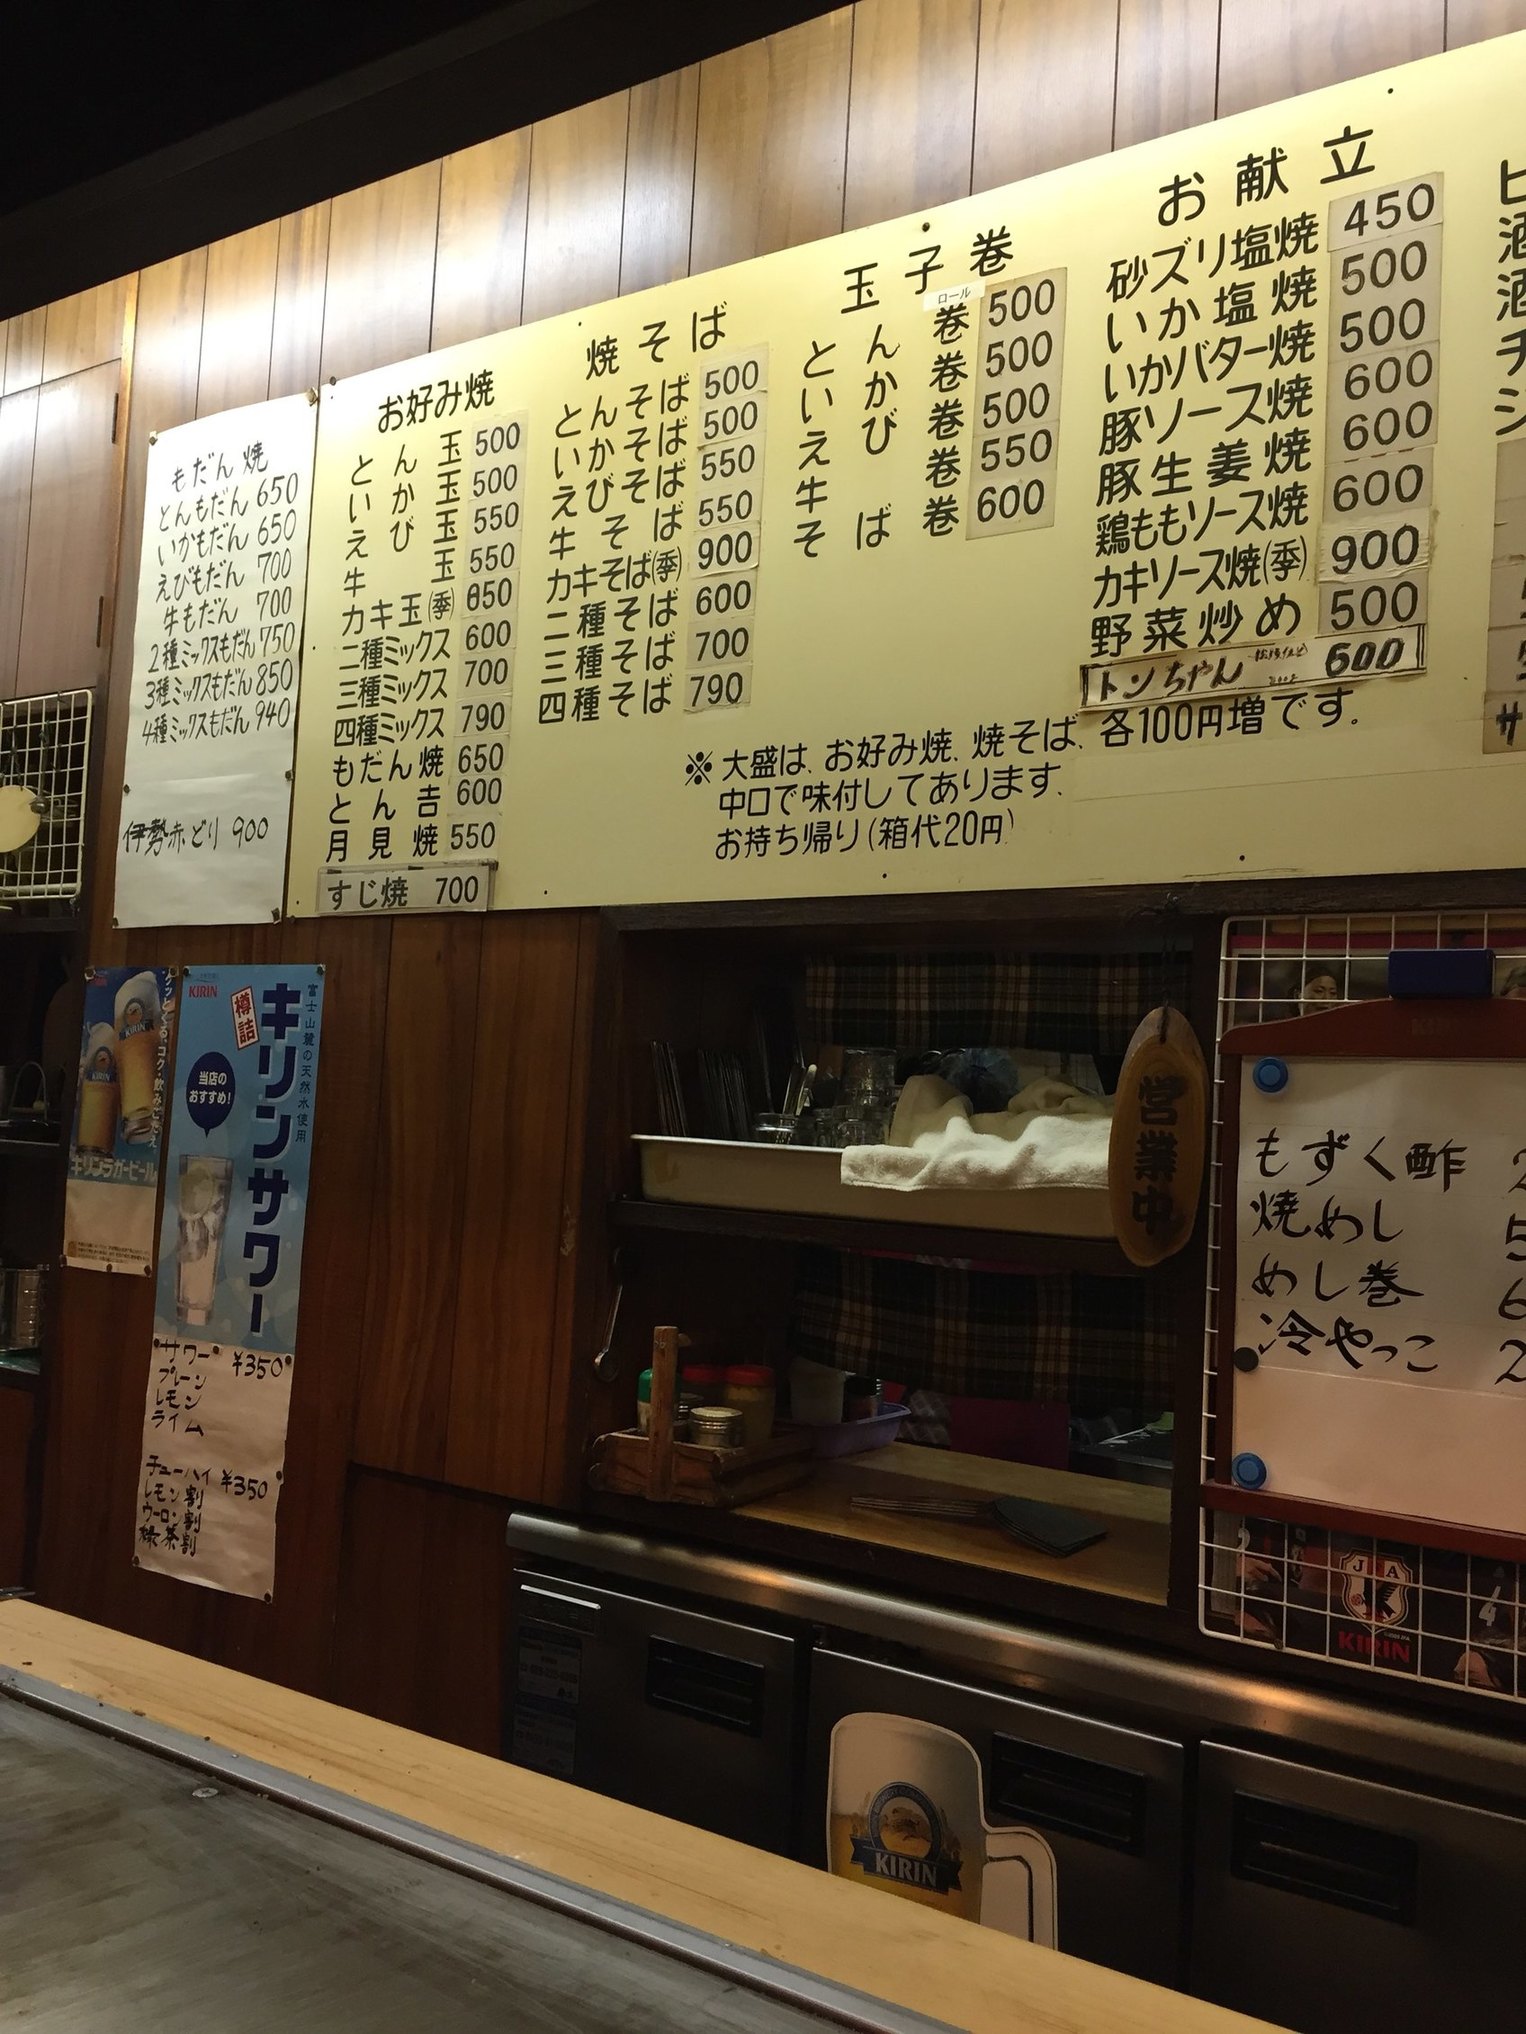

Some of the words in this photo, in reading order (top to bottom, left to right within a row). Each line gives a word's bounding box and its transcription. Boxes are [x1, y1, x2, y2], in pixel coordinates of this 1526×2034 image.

[1157, 125, 1375, 226] お献立
[1106, 212, 1319, 303] 砂ズリ塩焼
[1344, 183, 1435, 236] 450
[840, 225, 1013, 314] 玉子巻
[938, 287, 971, 305] ロール
[989, 279, 1055, 327] 500
[1107, 264, 1318, 353] いか塩焼
[1341, 240, 1427, 296] 500
[586, 301, 727, 380] 焼そば
[986, 330, 1052, 377] 500
[1105, 319, 1315, 402] いかバター焼
[1340, 298, 1425, 353] 500
[378, 369, 495, 433] お好み焼
[556, 373, 689, 438] とんそば
[705, 360, 758, 400] 500
[983, 382, 1050, 429] 500
[1100, 372, 1313, 456] 豚ソース焼
[1345, 349, 1433, 400] 600
[476, 422, 520, 456] 500
[555, 416, 687, 479] いかそば
[704, 401, 758, 439] 500
[981, 429, 1052, 472] 550
[1096, 426, 1311, 507] 豚生姜焼
[1343, 400, 1433, 451] 600
[172, 441, 268, 492] もだん焼
[473, 464, 517, 497] 500
[552, 458, 686, 520] えびそば
[702, 444, 755, 481] 550
[160, 486, 248, 532] とんもだん
[257, 473, 298, 507] 650
[474, 502, 518, 534] 550
[699, 490, 752, 527] 550
[977, 479, 1044, 523] 600
[1095, 480, 1308, 557] 鶏ももソース焼
[1333, 464, 1423, 512] 600
[158, 523, 249, 566] いかもだん
[258, 509, 296, 546] 650
[470, 543, 514, 573] 550
[698, 531, 752, 570] 900
[1332, 524, 1419, 575] 900
[156, 560, 245, 604] えびもだん
[258, 548, 291, 584] 700
[163, 598, 238, 637] 牛もだん
[257, 586, 292, 621] 700
[544, 588, 678, 640] 二種そば
[696, 580, 751, 615] 600
[1090, 593, 1301, 659] 野菜炒め
[1330, 581, 1418, 631] 500
[260, 622, 295, 657] 750
[339, 630, 450, 670] 二種ミックス
[466, 620, 511, 650] 600
[541, 631, 675, 684] 三種そば
[696, 627, 749, 662] 700
[1325, 638, 1405, 678] 600
[256, 659, 293, 696] 850
[337, 668, 447, 709] 三種ミックス
[465, 658, 508, 687] 700
[539, 673, 672, 724] 四種そば
[690, 672, 743, 707] 790
[256, 698, 290, 731] 940
[334, 708, 444, 747] 四種ミックス
[461, 702, 505, 732] 790
[333, 744, 443, 787] もだん焼
[459, 742, 503, 773] 650
[457, 778, 501, 805] 600
[233, 816, 268, 848] 900
[451, 822, 495, 850] 550
[328, 876, 408, 911] すじ焼
[436, 876, 478, 904] 700
[188, 985, 218, 998] KIRIN
[124, 1021, 146, 1039] KIRIN
[234, 991, 256, 1044] 樽詰
[198, 1072, 227, 1086] 当店の
[296, 984, 318, 1143] 富士山麓の天然水使用
[189, 1090, 231, 1104] おすすめ!
[243, 982, 301, 1334] キリンサワー
[1255, 1126, 1468, 1193] もずく酢
[1250, 1189, 1404, 1245] 焼めし
[1251, 1252, 1424, 1308] めし巻
[159, 1339, 210, 1365] サワー
[232, 1350, 283, 1380] ¥350
[1258, 1308, 1438, 1373] 冷やっこ
[151, 1410, 204, 1437] ライム
[156, 1389, 202, 1410] レモン
[146, 1455, 211, 1485] チューハイ
[221, 1469, 268, 1500] ¥350
[1338, 1631, 1410, 1663] KIRIN
[875, 1853, 937, 1887] KIRIN
